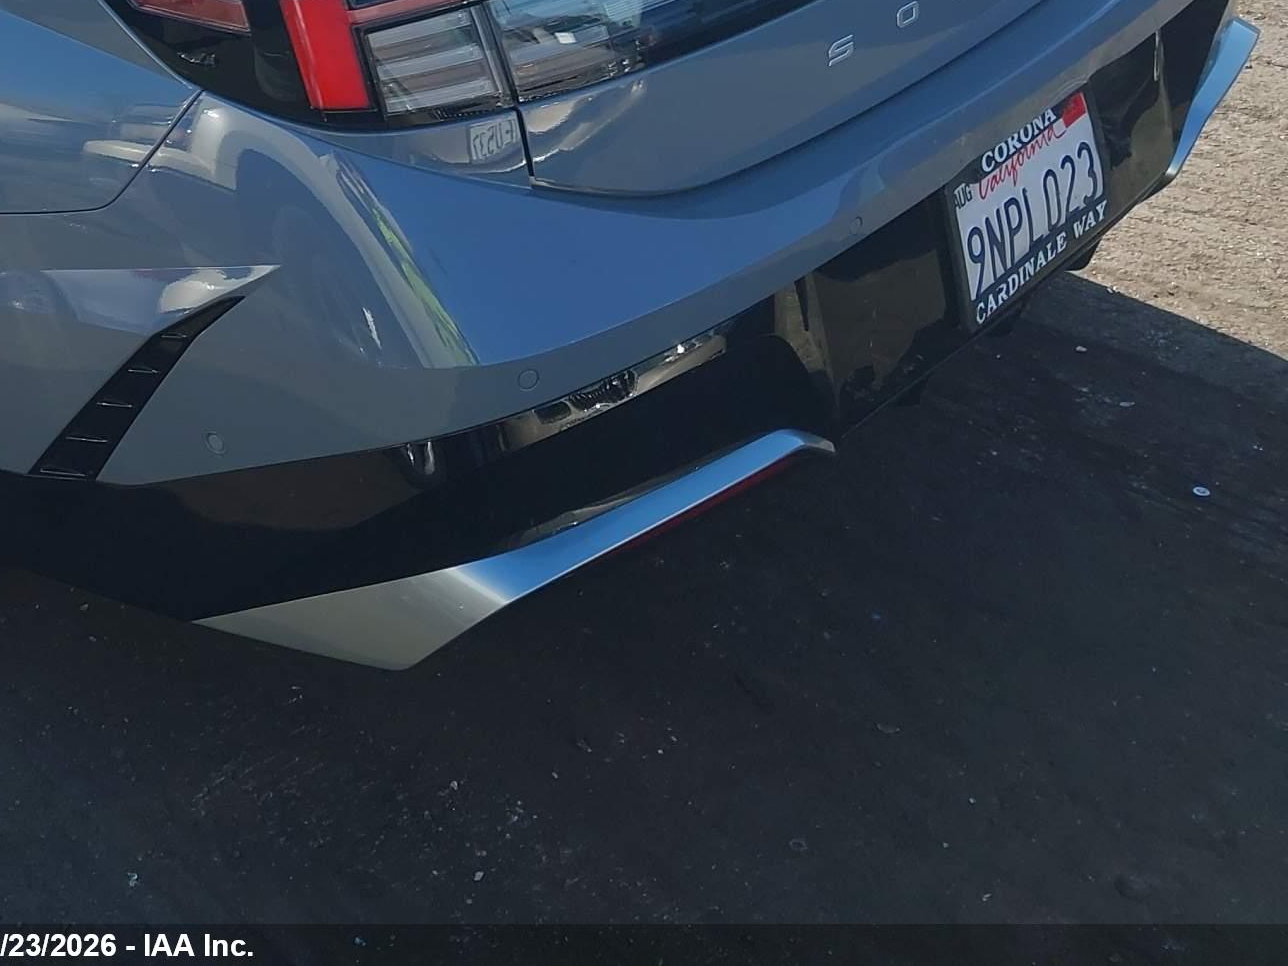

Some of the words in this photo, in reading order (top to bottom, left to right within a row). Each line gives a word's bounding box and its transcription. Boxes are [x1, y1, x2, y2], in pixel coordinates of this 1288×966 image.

[978, 124, 1067, 201] California
[981, 108, 1057, 172] CORONA
[953, 183, 973, 210] AUG
[966, 140, 1100, 301] 9NPL023
[975, 232, 1068, 325] CARDINALE
[1073, 200, 1108, 239] WAY
